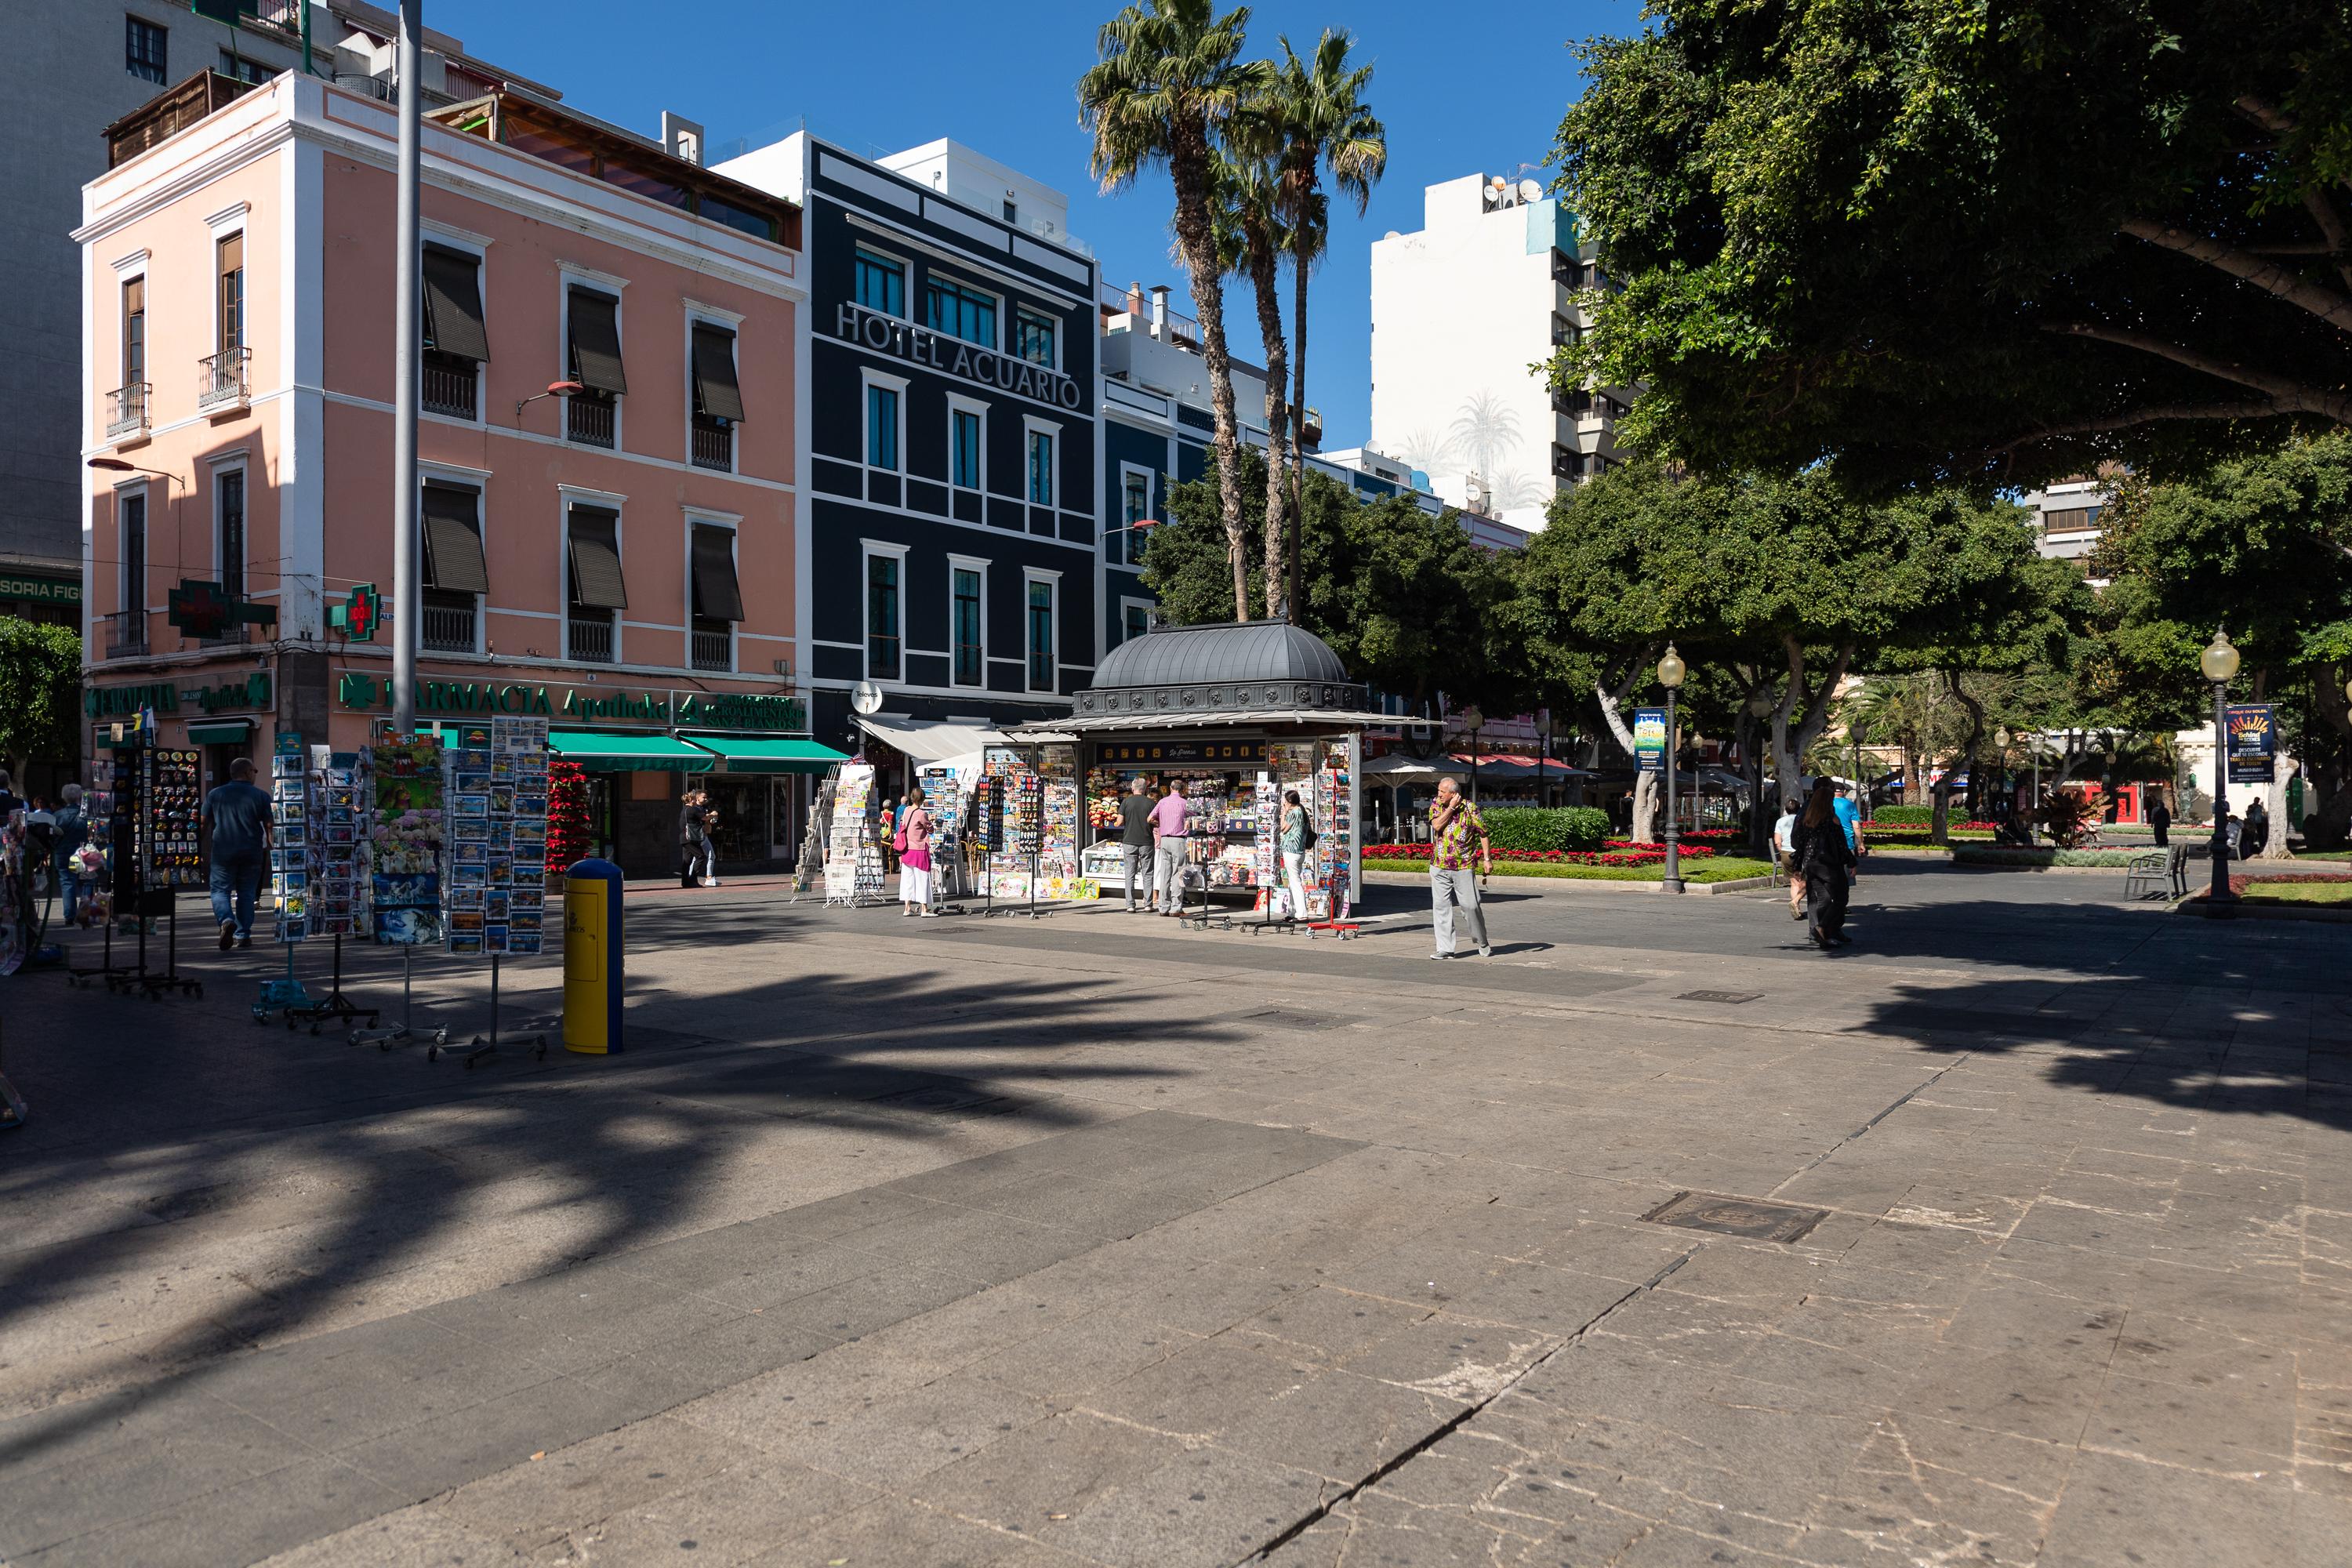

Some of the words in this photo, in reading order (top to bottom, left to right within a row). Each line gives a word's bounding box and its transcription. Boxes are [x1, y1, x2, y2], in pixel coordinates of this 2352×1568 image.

[836, 303, 944, 368] HOTEL
[951, 344, 1081, 409] ACUARIO
[99, 682, 176, 715] FARMACIA
[563, 688, 670, 721] Apotheke
[717, 694, 792, 707] LABORATORIO
[702, 703, 806, 719] AGROALIMENTARIO
[406, 735, 419, 745] 3D
